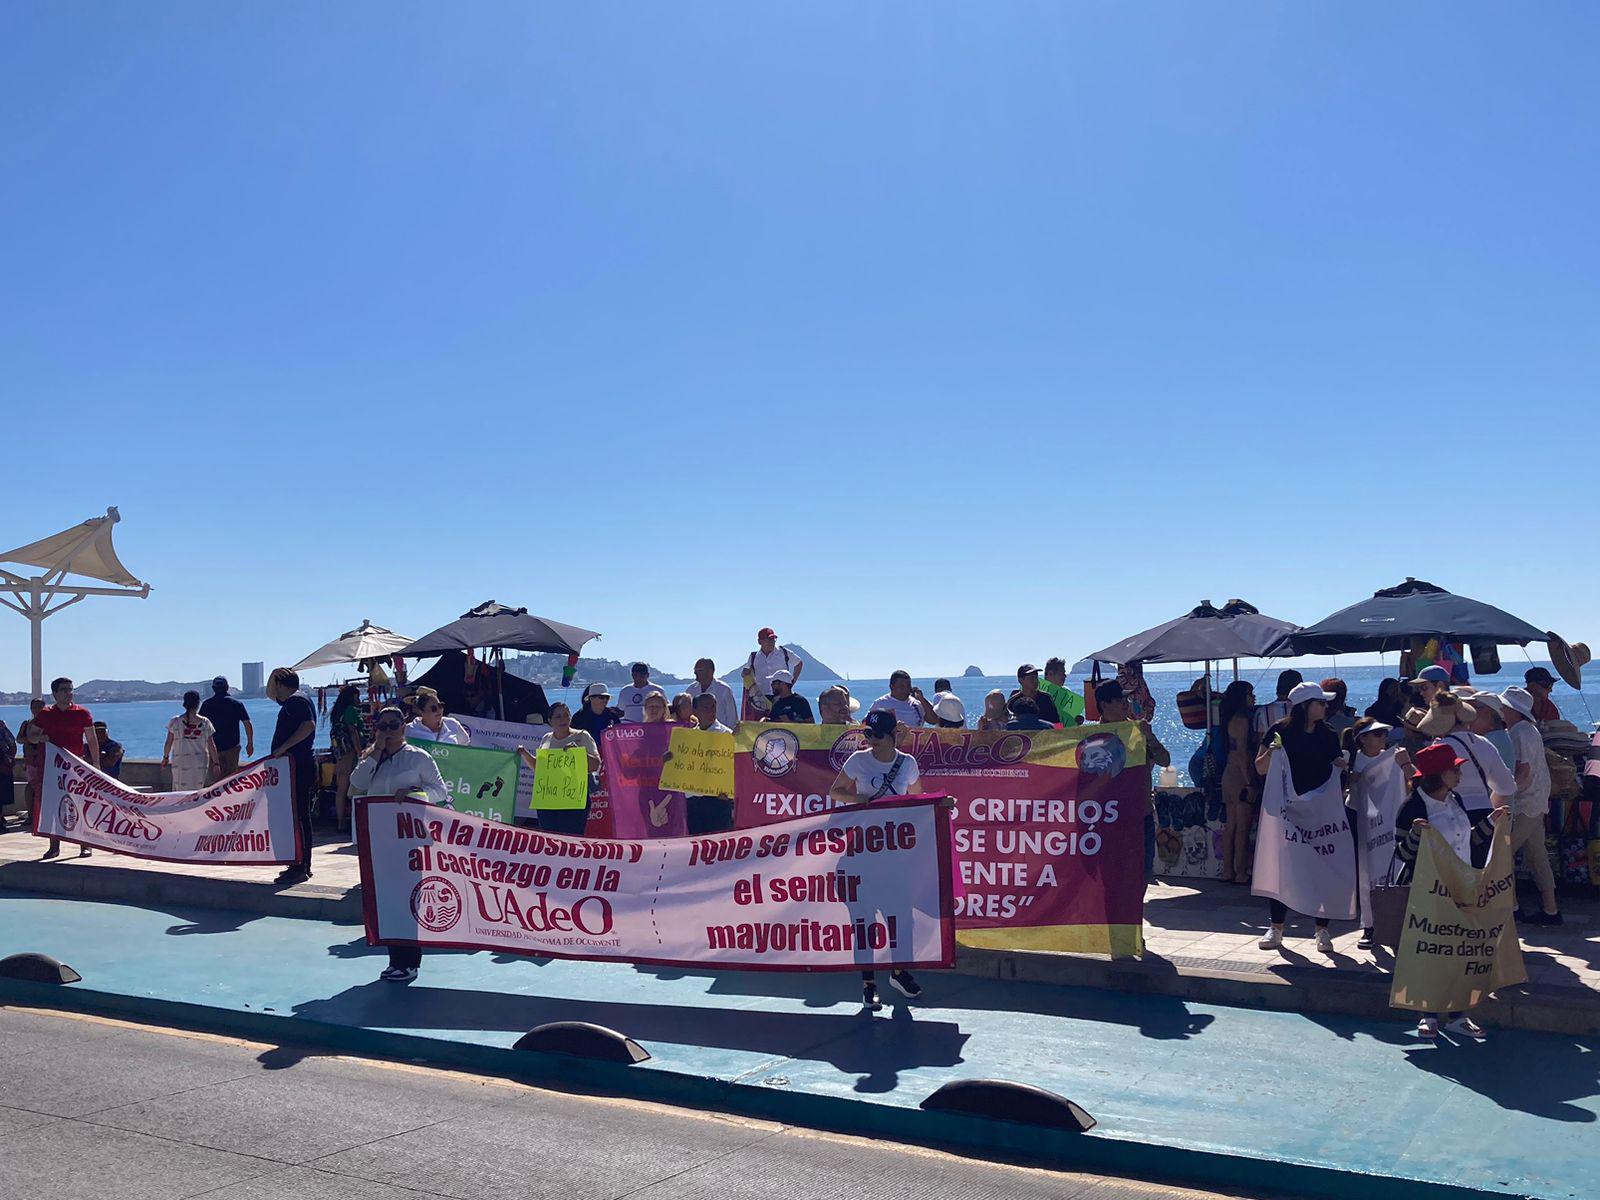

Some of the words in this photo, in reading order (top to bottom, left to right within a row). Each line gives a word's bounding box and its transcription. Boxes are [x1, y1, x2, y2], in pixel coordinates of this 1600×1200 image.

[475, 729, 520, 740] UNIVERSIDAD
[616, 728, 644, 739] UAdeO
[678, 743, 690, 754] No
[546, 753, 576, 770] FUERA
[674, 760, 686, 770] No
[982, 769, 1029, 778] OCCIDENTE
[457, 777, 471, 795] la
[205, 806, 224, 822] el
[968, 798, 1119, 824] CRITERIOS
[194, 830, 271, 854] mayoritario!
[396, 812, 427, 839] No
[428, 820, 444, 843] a
[447, 819, 474, 846] la
[477, 822, 624, 860] imposición
[628, 843, 643, 863] y
[688, 834, 753, 866] ¡Que
[756, 833, 791, 858] se
[795, 821, 917, 857] respete
[955, 828, 986, 853] SE
[995, 824, 1102, 857] UNGIÓ
[1284, 829, 1298, 843] LA
[408, 844, 432, 871] al
[436, 851, 552, 889] cacicazgo
[556, 866, 591, 890] en
[593, 865, 621, 892] la
[960, 861, 1027, 887] ENTE
[1036, 864, 1058, 887] A
[733, 873, 764, 906] el
[769, 869, 861, 903] sentir
[469, 880, 614, 936] UAdeO
[475, 926, 523, 940] UNIVERSIDAD
[564, 936, 575, 946] DE
[706, 915, 898, 954] mayoritario!
[1408, 914, 1486, 939] Muestren
[1416, 940, 1453, 955] para
